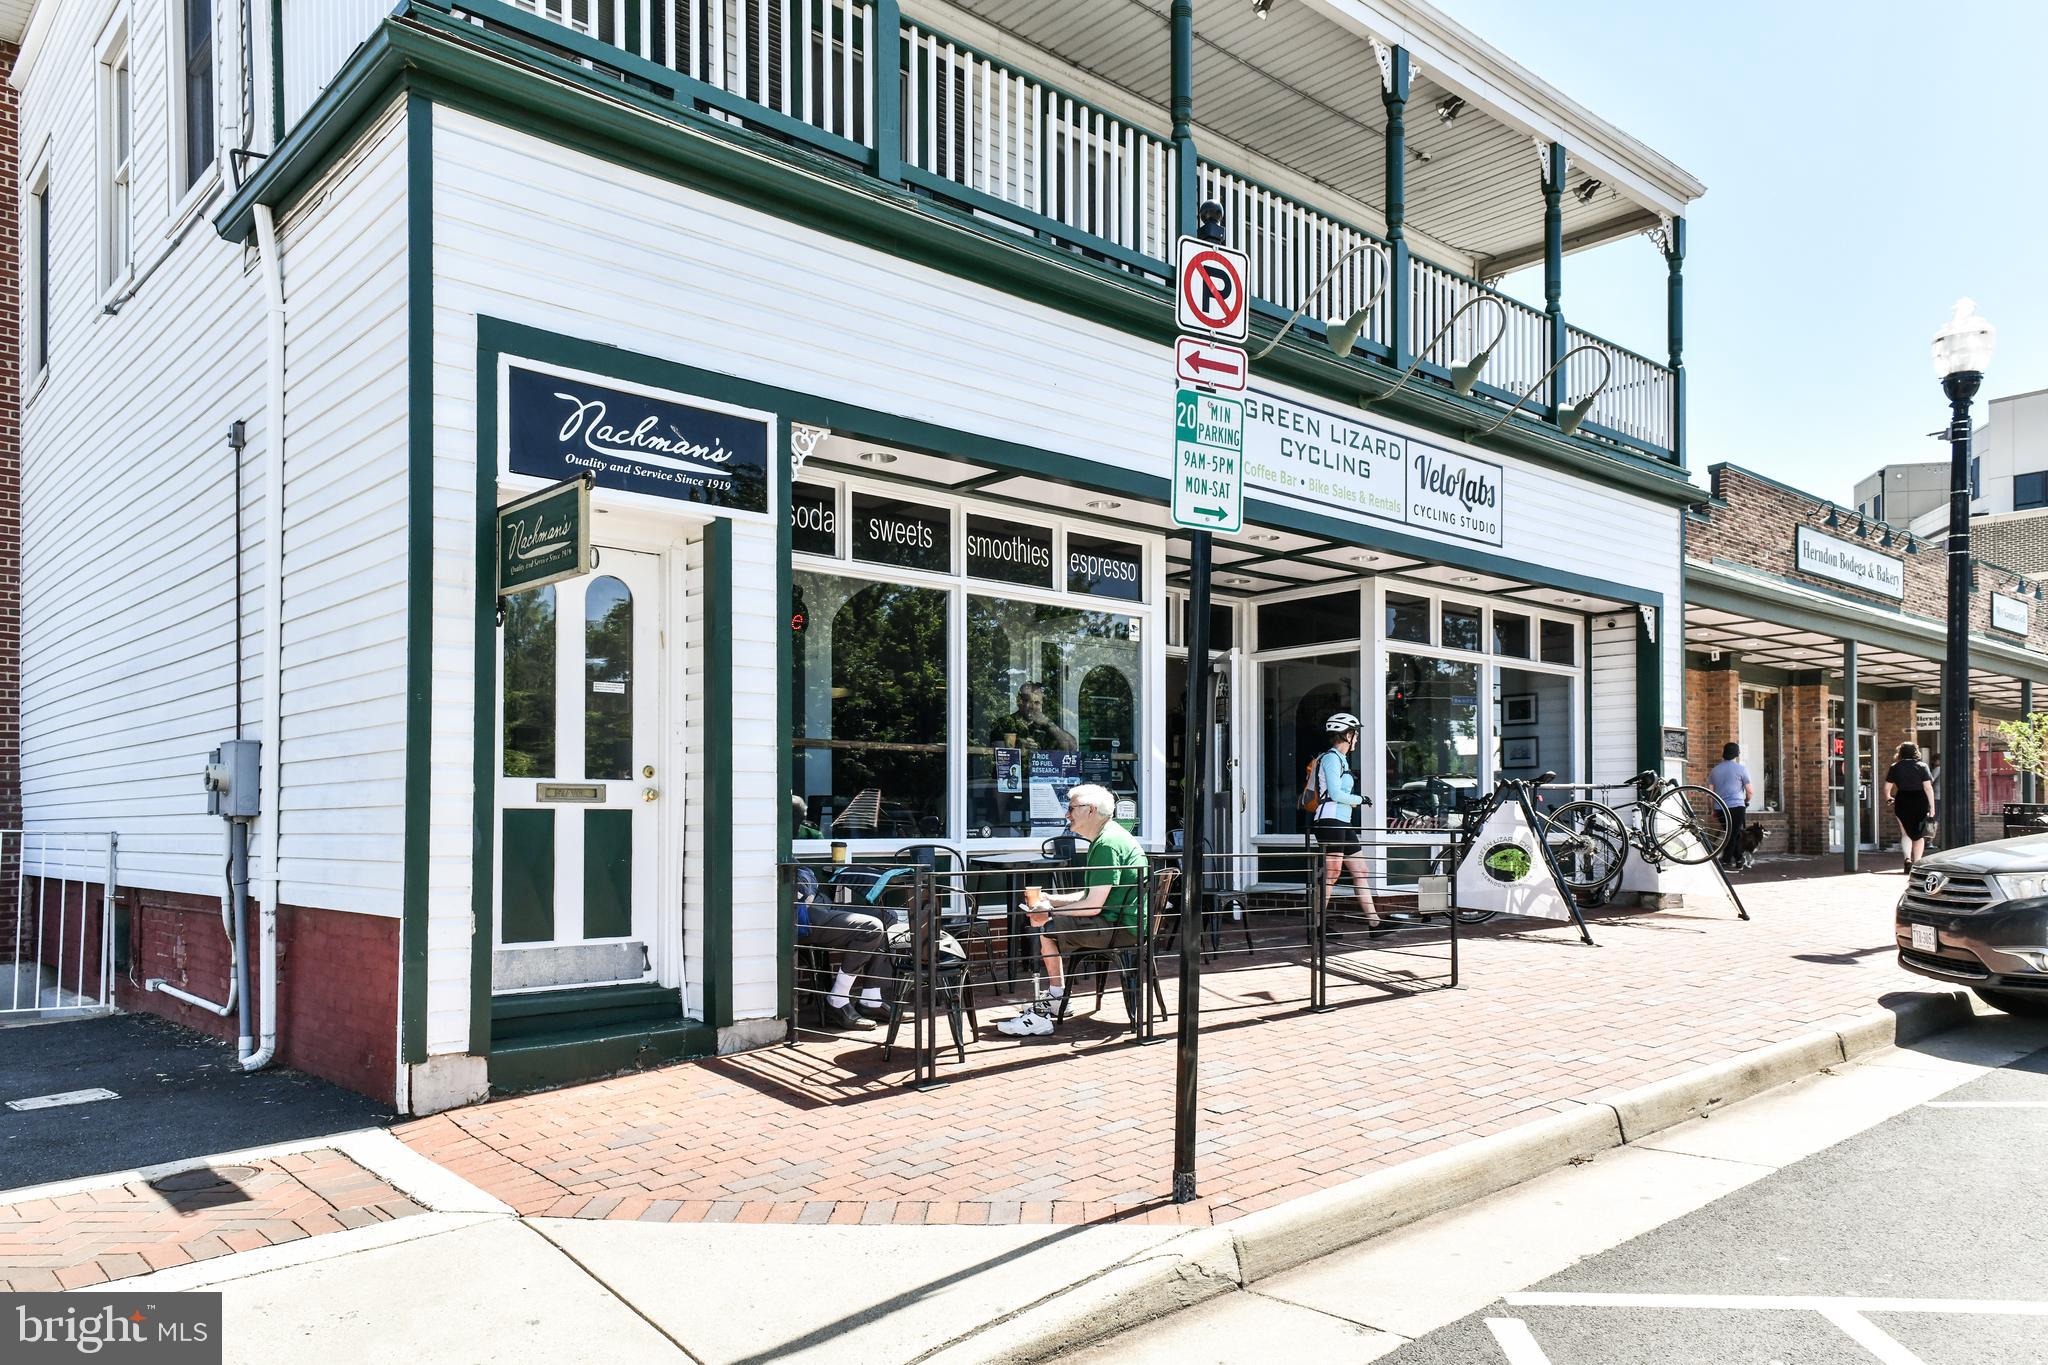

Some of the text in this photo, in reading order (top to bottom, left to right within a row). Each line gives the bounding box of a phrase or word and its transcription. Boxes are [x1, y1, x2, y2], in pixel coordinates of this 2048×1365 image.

[1177, 402, 1231, 429] 20 MIN
[1244, 398, 1401, 461] GREEN LIZARD
[554, 392, 732, 475] Nachman's
[1198, 422, 1240, 447] PARKING
[565, 453, 731, 491] Quality and Service Since 1919
[1184, 450, 1234, 475] 9AM-5PM
[1281, 437, 1371, 479] CYCLING
[1185, 476, 1231, 500] MON-SAT
[1244, 460, 1401, 513] Coffee Bar Bike Sales & Rentals
[1414, 454, 1496, 513] VeloLabs
[507, 512, 572, 560] Nachman's
[869, 517, 933, 549] sweets
[1413, 503, 1496, 535] CYCLING STUDIO
[967, 533, 1050, 568] smoothies
[1070, 551, 1137, 582] espresso
[1803, 539, 1900, 591] Herndon Bodega & Bakery
[1493, 836, 1514, 844] LIZAR
